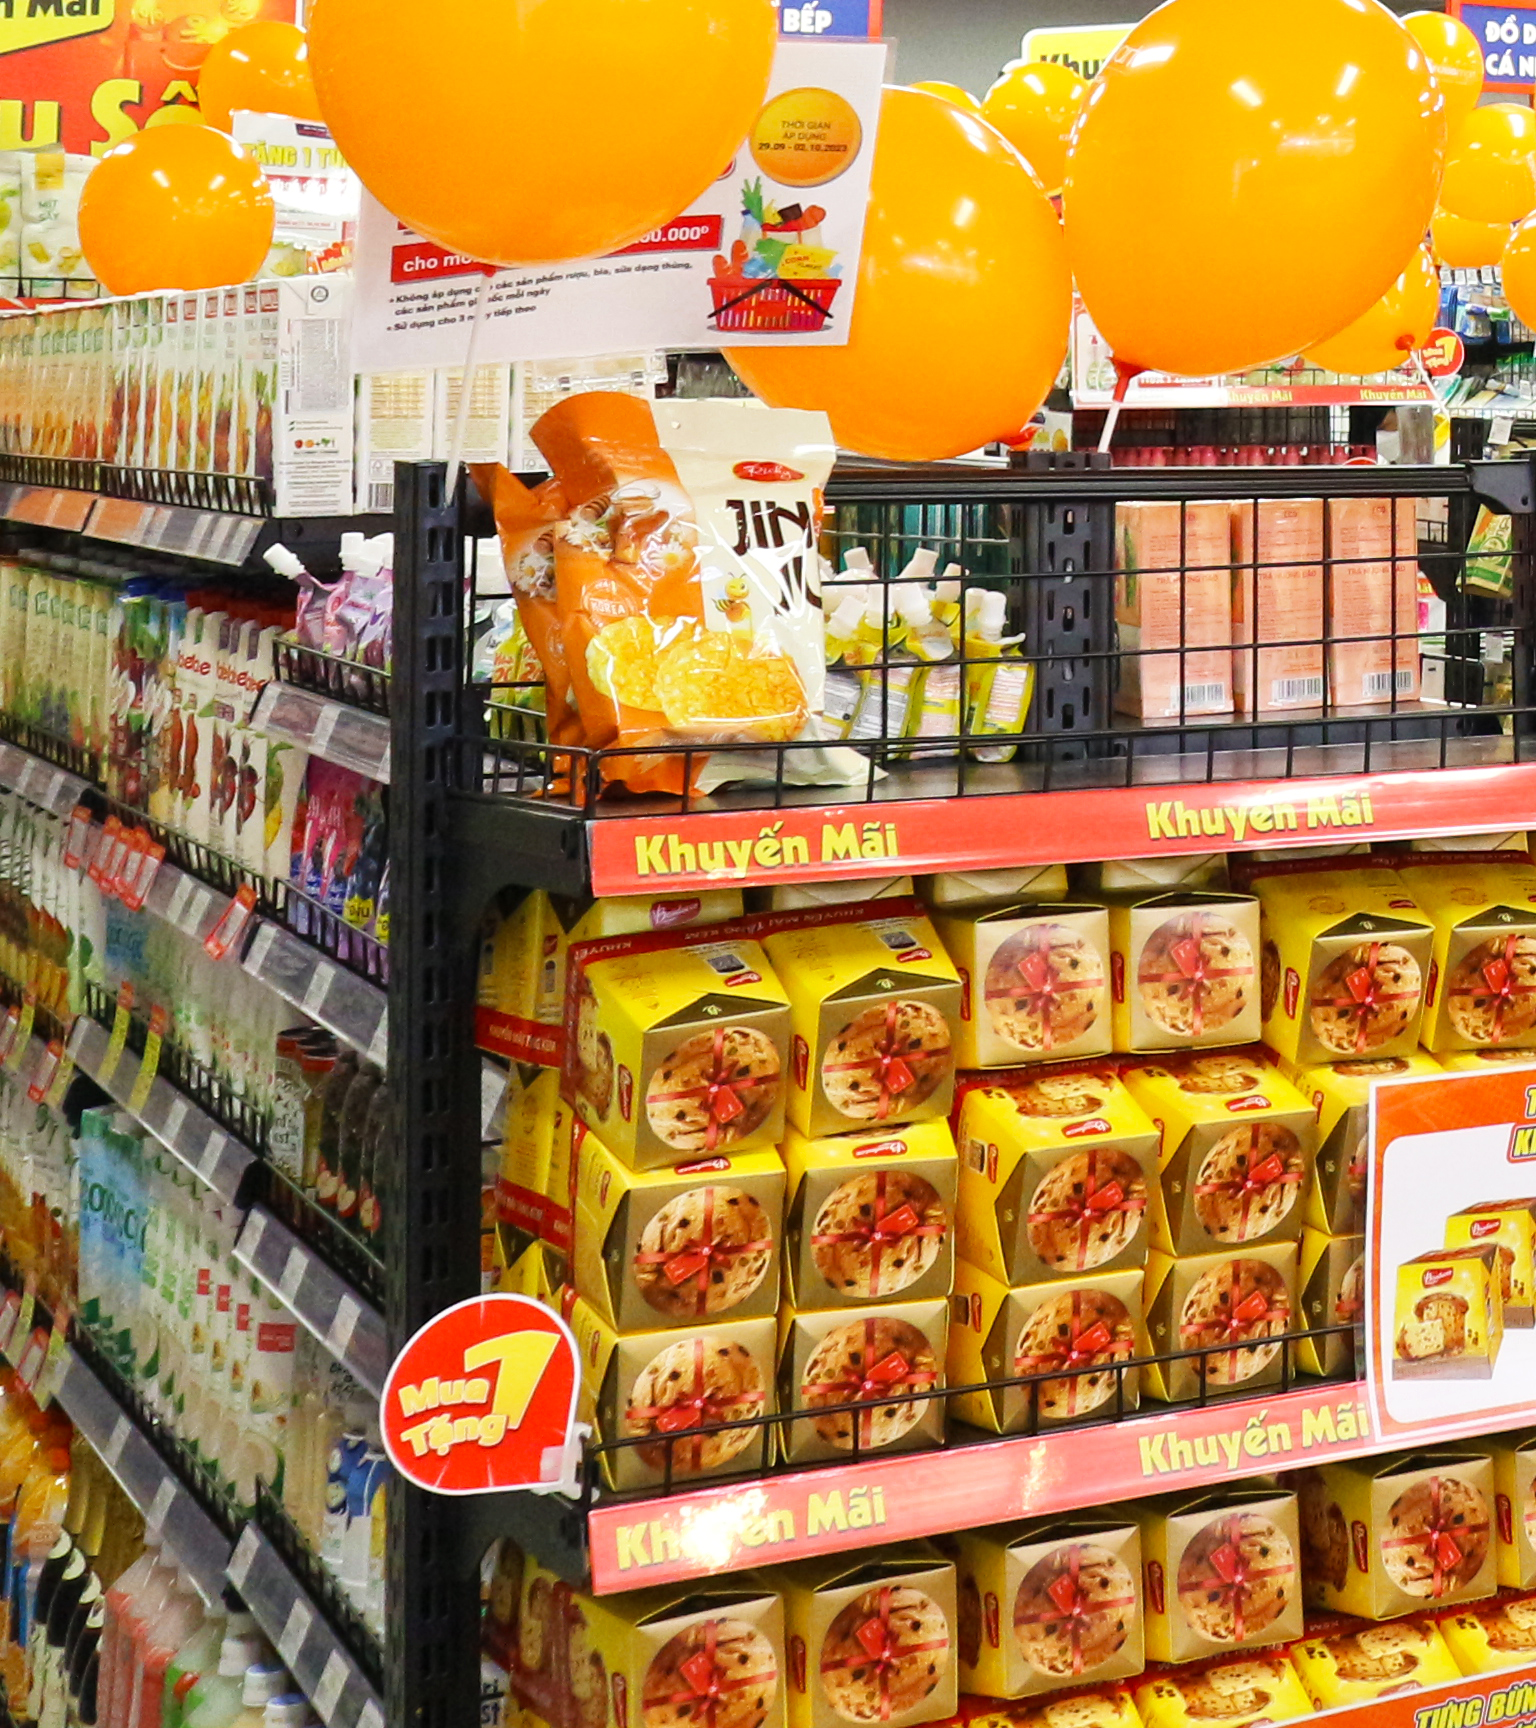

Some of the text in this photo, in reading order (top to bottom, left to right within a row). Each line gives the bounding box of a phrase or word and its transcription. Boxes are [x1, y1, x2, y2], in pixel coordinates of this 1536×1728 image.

[783, 1, 832, 33] BẾP
[1485, 49, 1515, 76] CÁ
[403, 253, 440, 272] cho
[493, 304, 536, 320] tiếp theo
[1146, 790, 1374, 843] Khuyến Mãi
[634, 818, 901, 880] Khuyến Mãi
[398, 1375, 490, 1418] Mua
[399, 1410, 509, 1457] Tặng
[1137, 1400, 1370, 1477] Khuyến Mãi
[806, 1485, 887, 1536] Mãi
[1415, 1693, 1484, 1726] TƯNG
